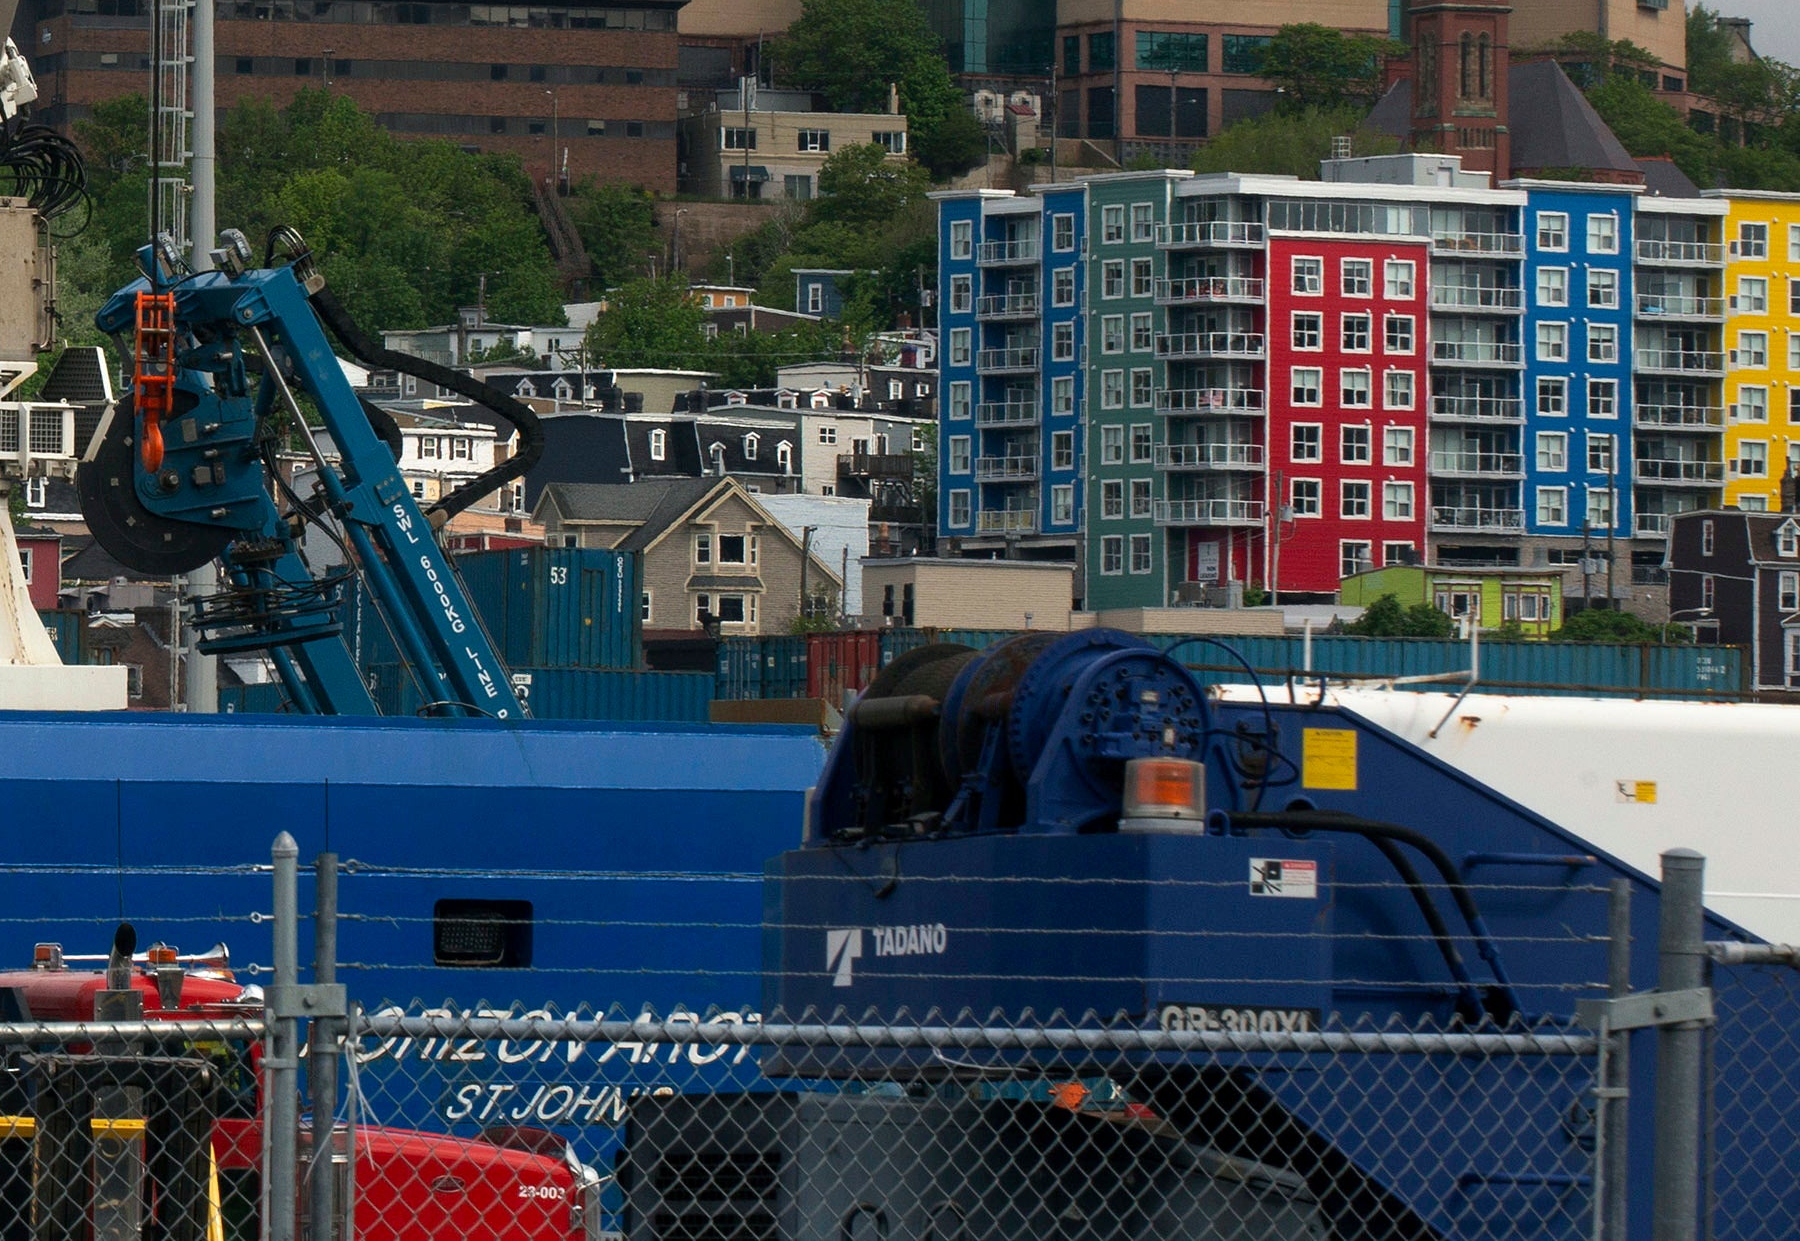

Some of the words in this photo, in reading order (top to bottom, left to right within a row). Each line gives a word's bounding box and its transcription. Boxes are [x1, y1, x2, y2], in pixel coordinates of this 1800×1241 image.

[393, 504, 419, 544] SWL
[420, 555, 466, 633] 6000KG
[465, 647, 498, 698] LINE
[872, 923, 947, 957] TADANO
